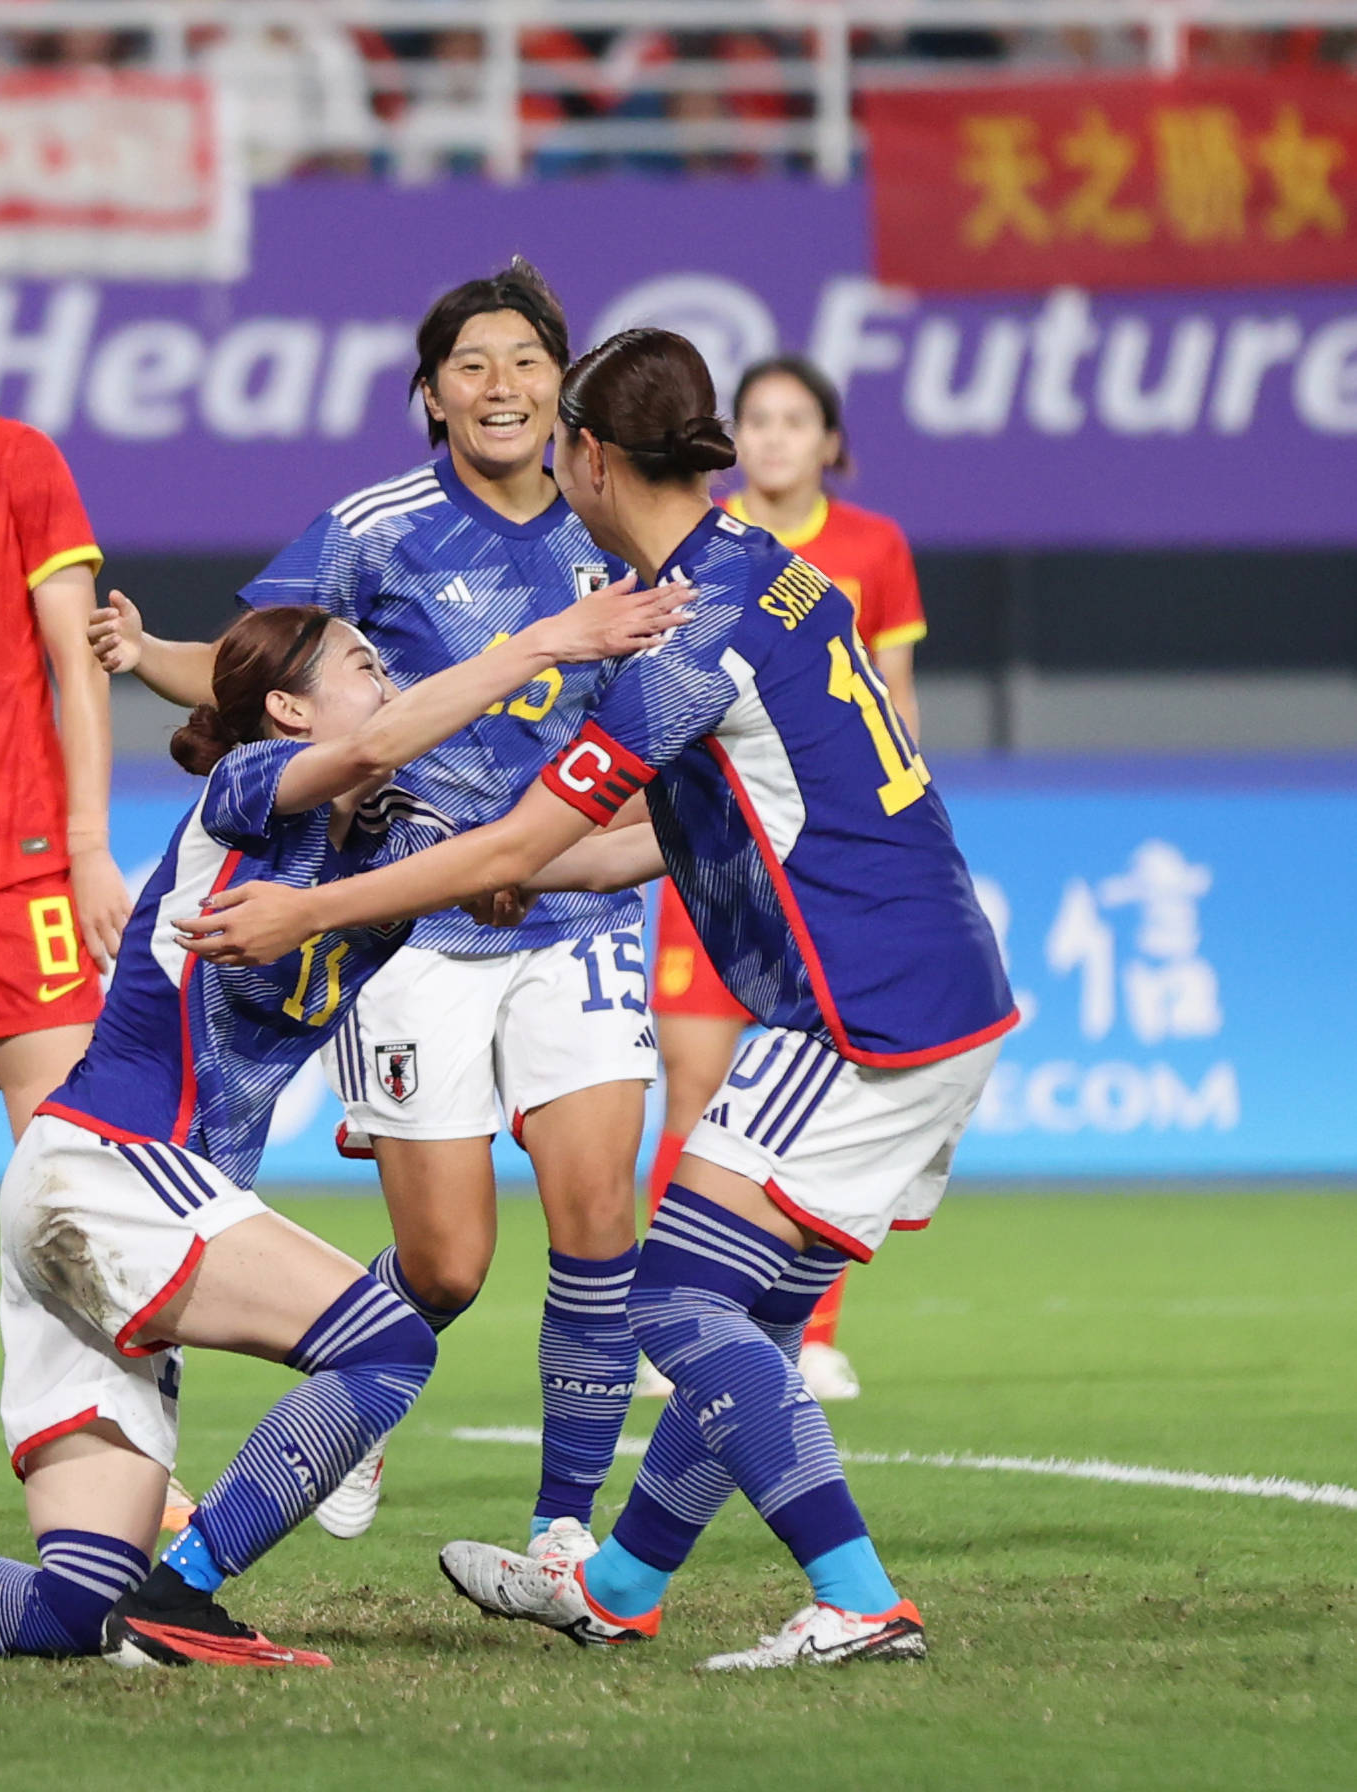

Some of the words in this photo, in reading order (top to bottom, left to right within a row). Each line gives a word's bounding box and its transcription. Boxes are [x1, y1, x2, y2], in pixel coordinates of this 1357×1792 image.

[558, 740, 612, 793] C
[29, 896, 80, 975] 8
[570, 931, 648, 1016] 15
